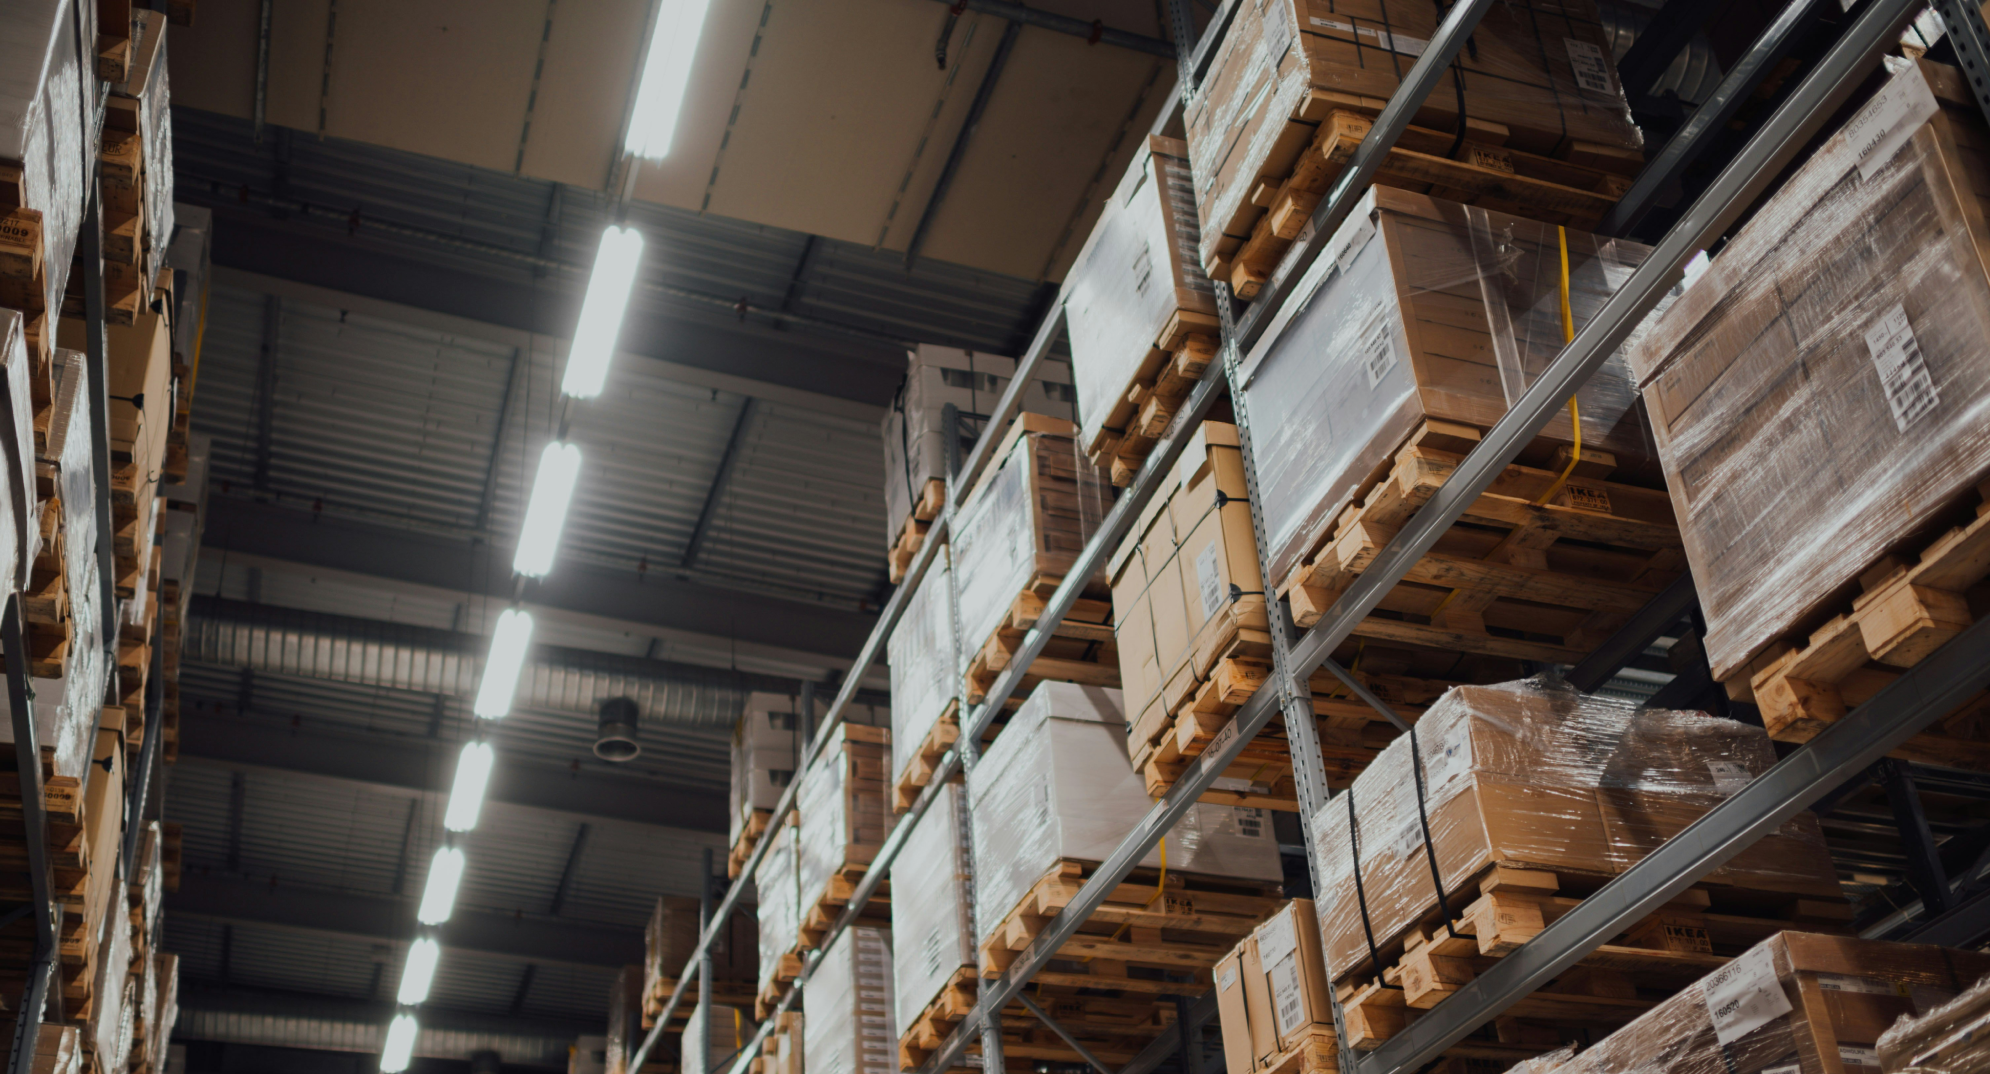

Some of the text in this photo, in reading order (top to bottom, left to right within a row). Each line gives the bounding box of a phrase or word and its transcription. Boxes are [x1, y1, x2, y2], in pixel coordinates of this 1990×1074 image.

[1858, 128, 1886, 159] 160430
[1570, 487, 1605, 499] IKEA
[1666, 926, 1706, 939] IKEA
[1705, 964, 1742, 991] 20366116
[1714, 999, 1740, 1019] 160520
